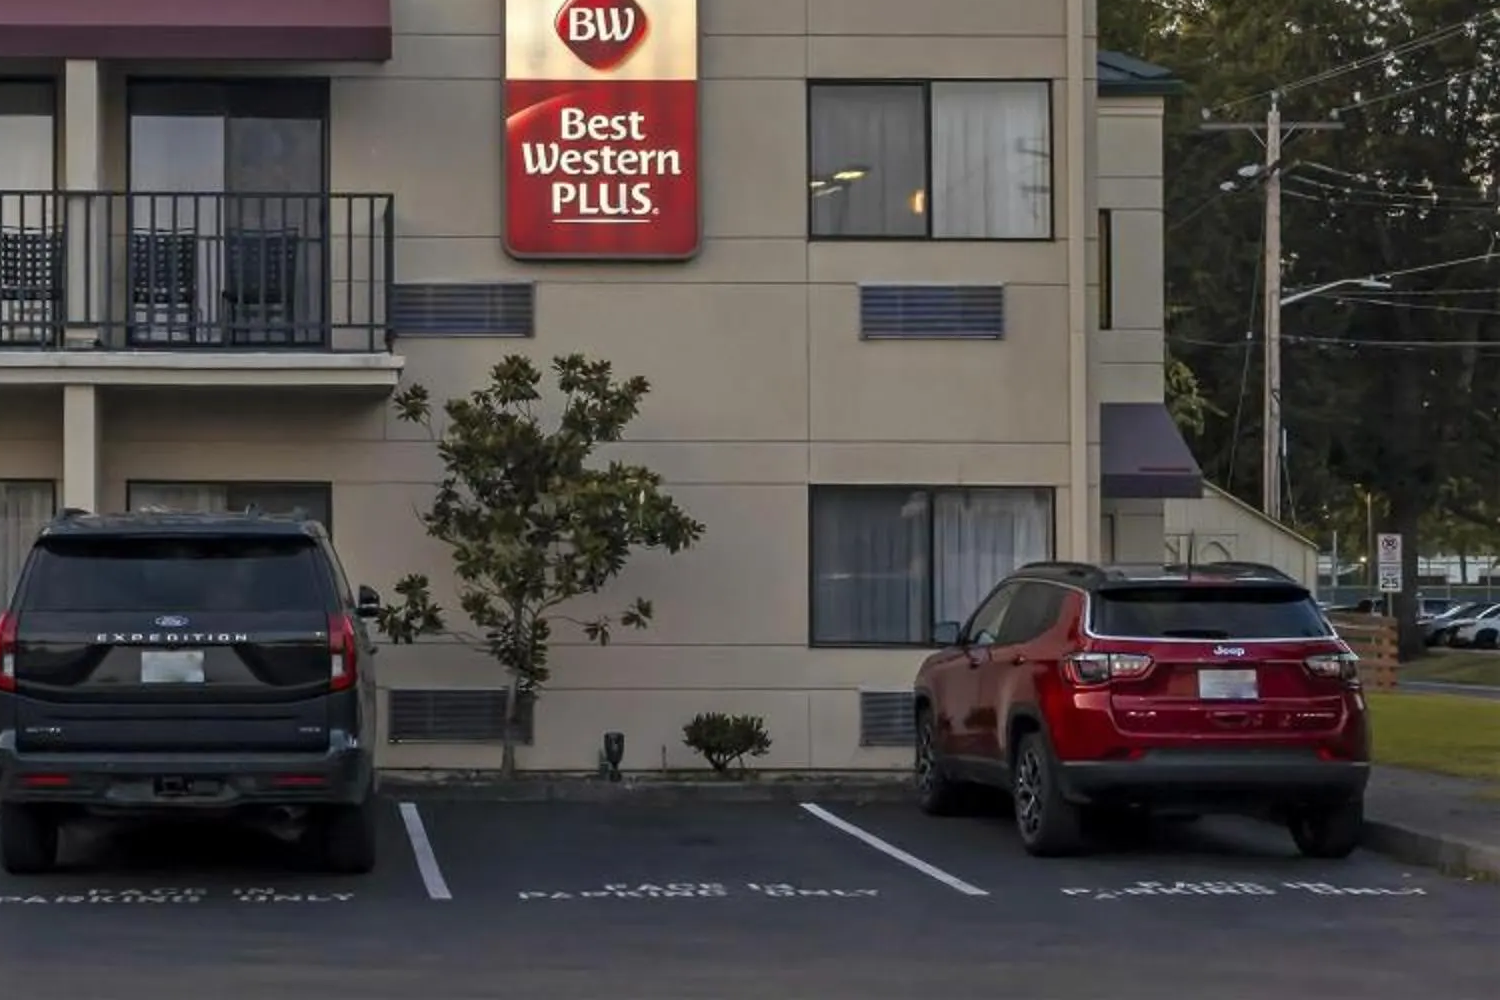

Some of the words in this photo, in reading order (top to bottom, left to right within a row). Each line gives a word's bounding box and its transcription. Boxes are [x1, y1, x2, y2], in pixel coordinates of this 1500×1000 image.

[568, 6, 636, 42] BW
[560, 106, 647, 141] Best
[521, 142, 682, 176] Western
[551, 182, 652, 216] PLUS
[96, 632, 248, 642] EXPEDITION
[1213, 645, 1245, 657] Jeep
[238, 893, 355, 902] ONLY
